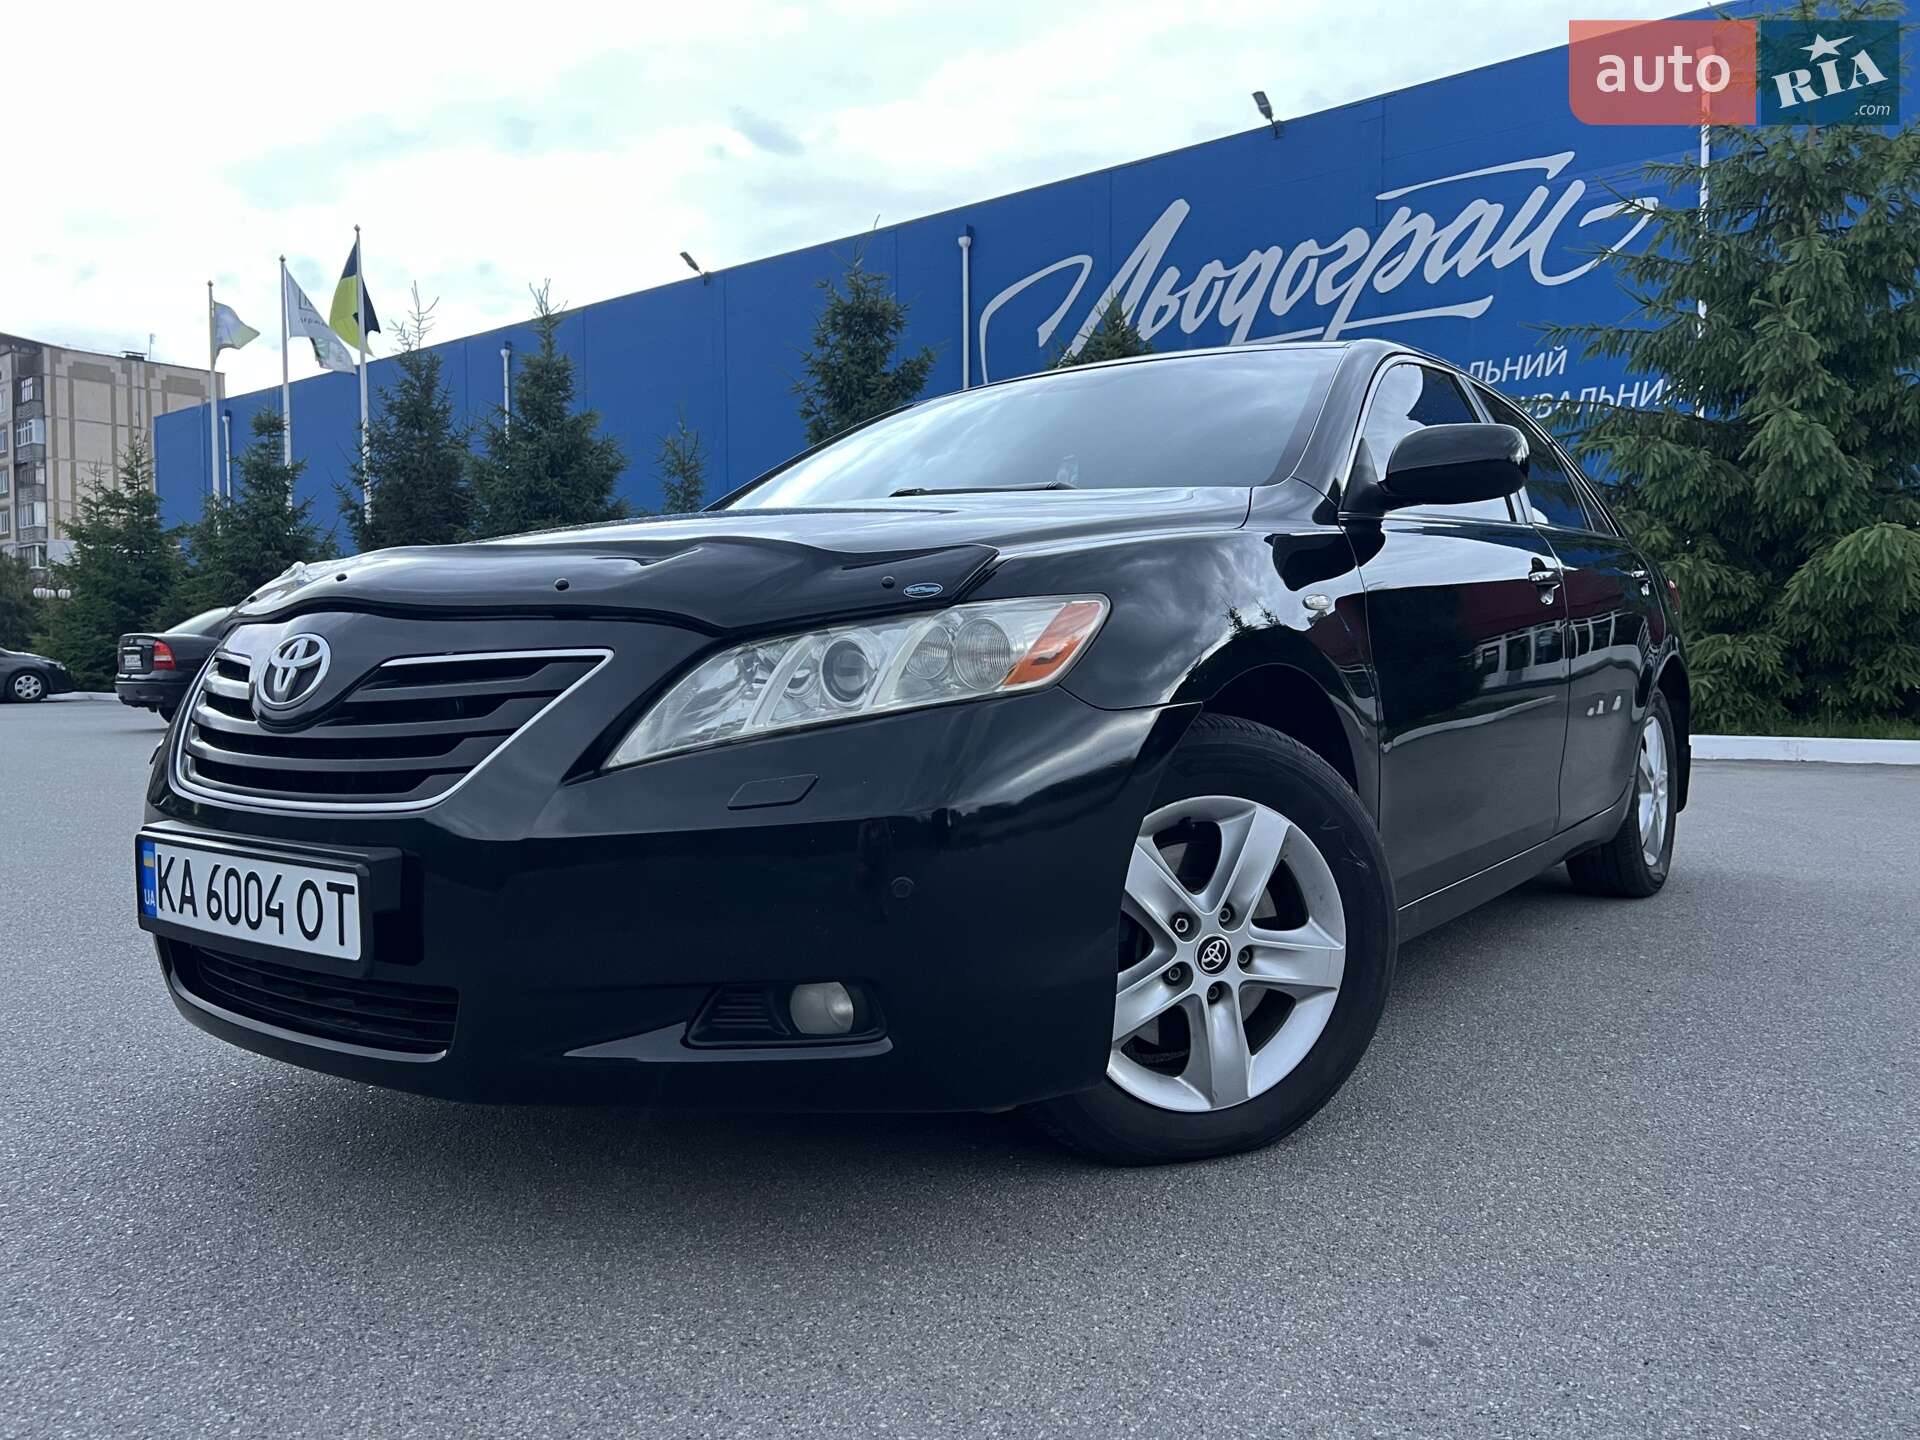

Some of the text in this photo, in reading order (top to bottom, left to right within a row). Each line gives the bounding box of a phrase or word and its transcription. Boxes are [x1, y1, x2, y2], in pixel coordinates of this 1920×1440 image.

[1456, 345, 1567, 384] ЛЬНИЙ
[143, 889, 156, 906] UA
[157, 854, 355, 946] KA 6004 OT
